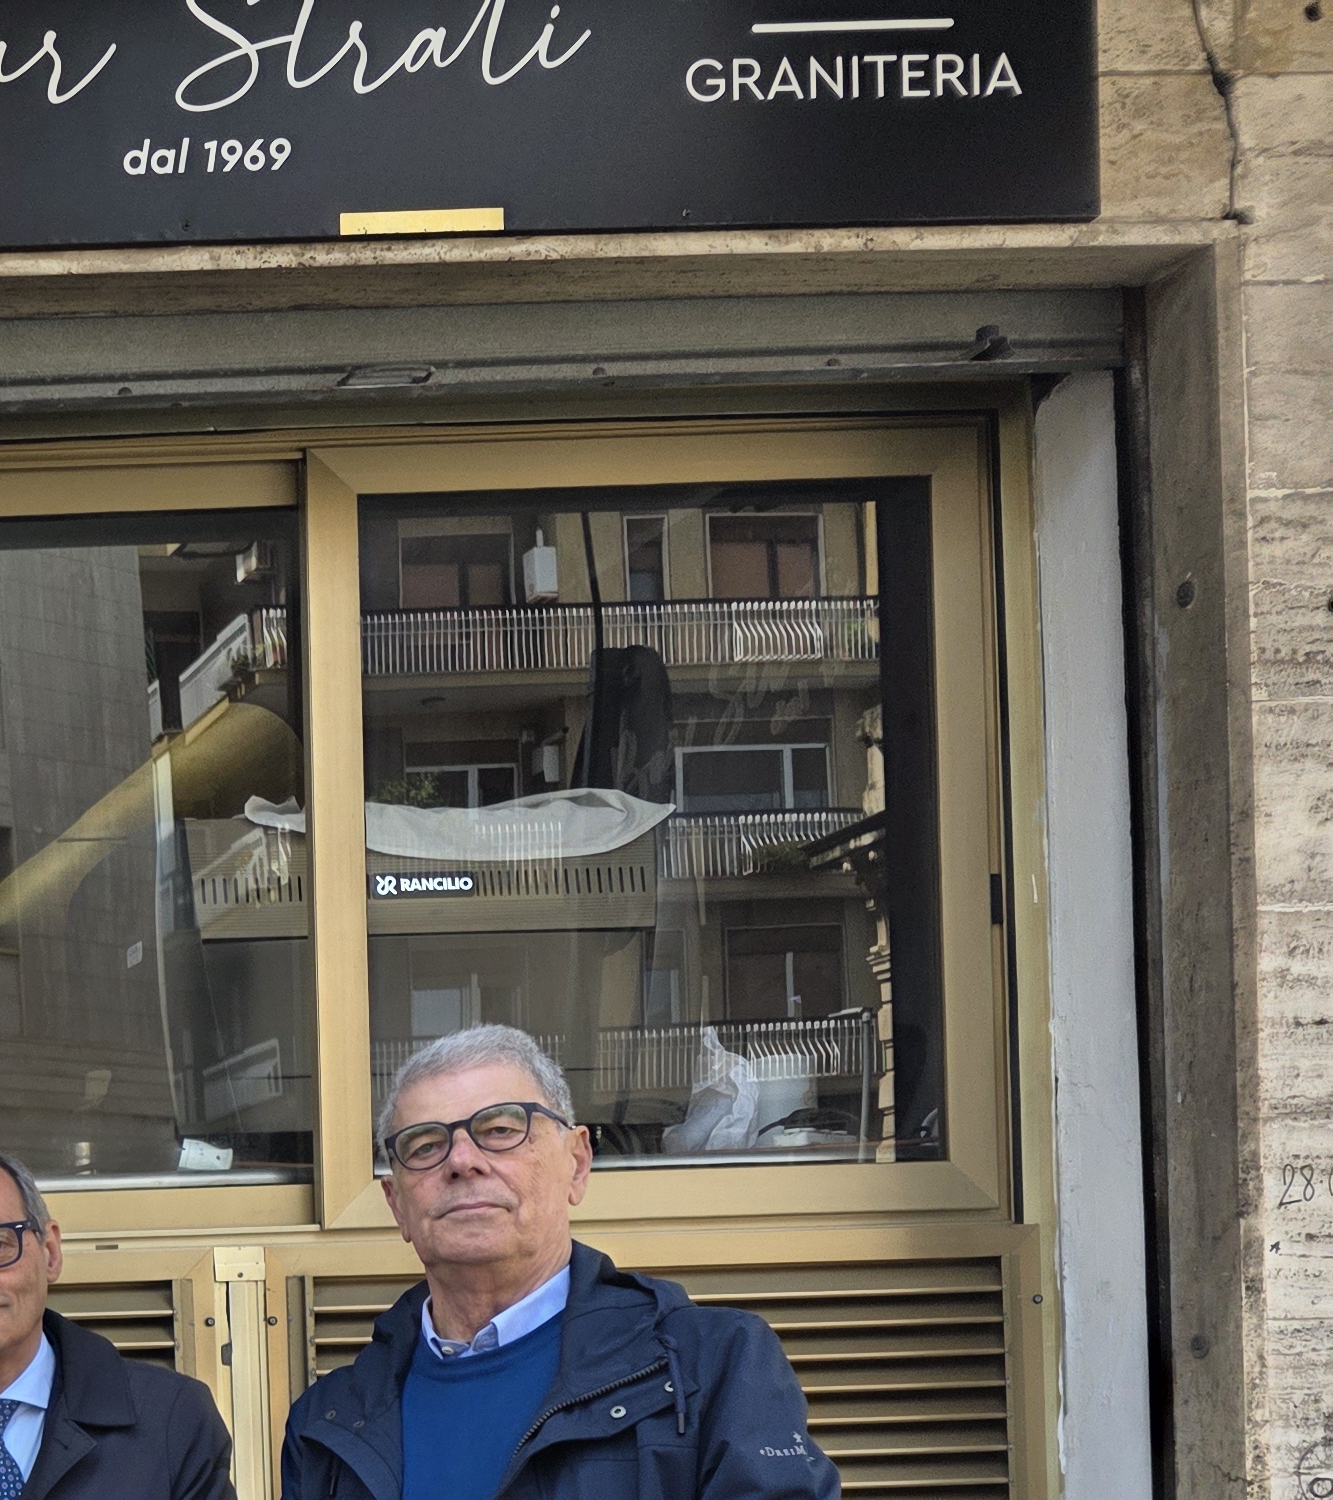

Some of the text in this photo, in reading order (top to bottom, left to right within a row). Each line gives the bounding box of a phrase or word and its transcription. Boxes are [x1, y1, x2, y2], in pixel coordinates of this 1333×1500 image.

[684, 52, 1023, 103] GRANITERIA
[123, 137, 292, 176] dal 1969
[399, 876, 473, 892] RANCILIO
